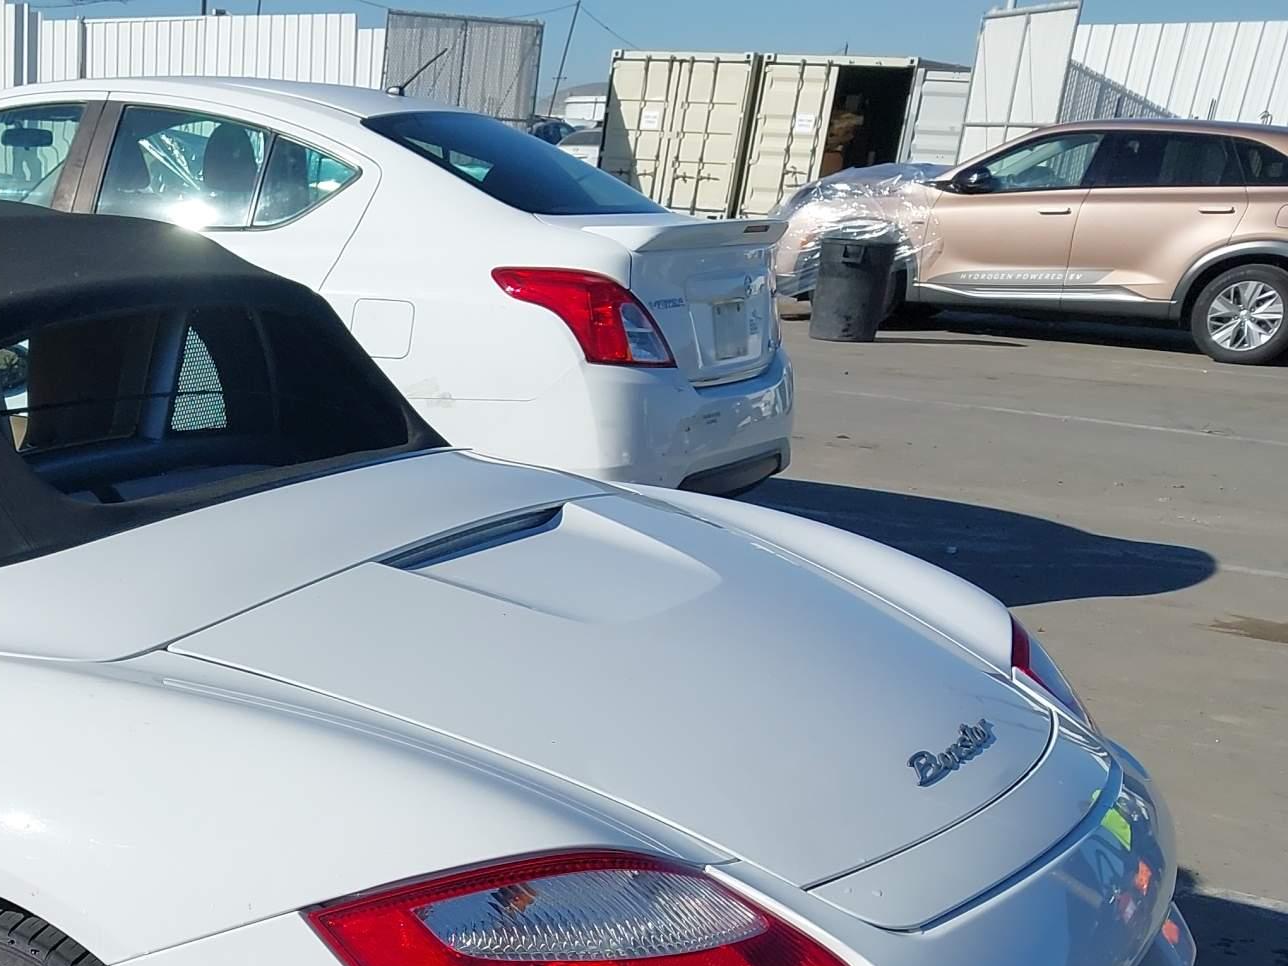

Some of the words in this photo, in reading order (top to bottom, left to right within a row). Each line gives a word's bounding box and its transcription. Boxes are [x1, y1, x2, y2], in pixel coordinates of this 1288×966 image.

[959, 272, 1014, 281] HYDROGEN
[1015, 272, 1064, 281] POWERED
[1068, 272, 1083, 281] EV
